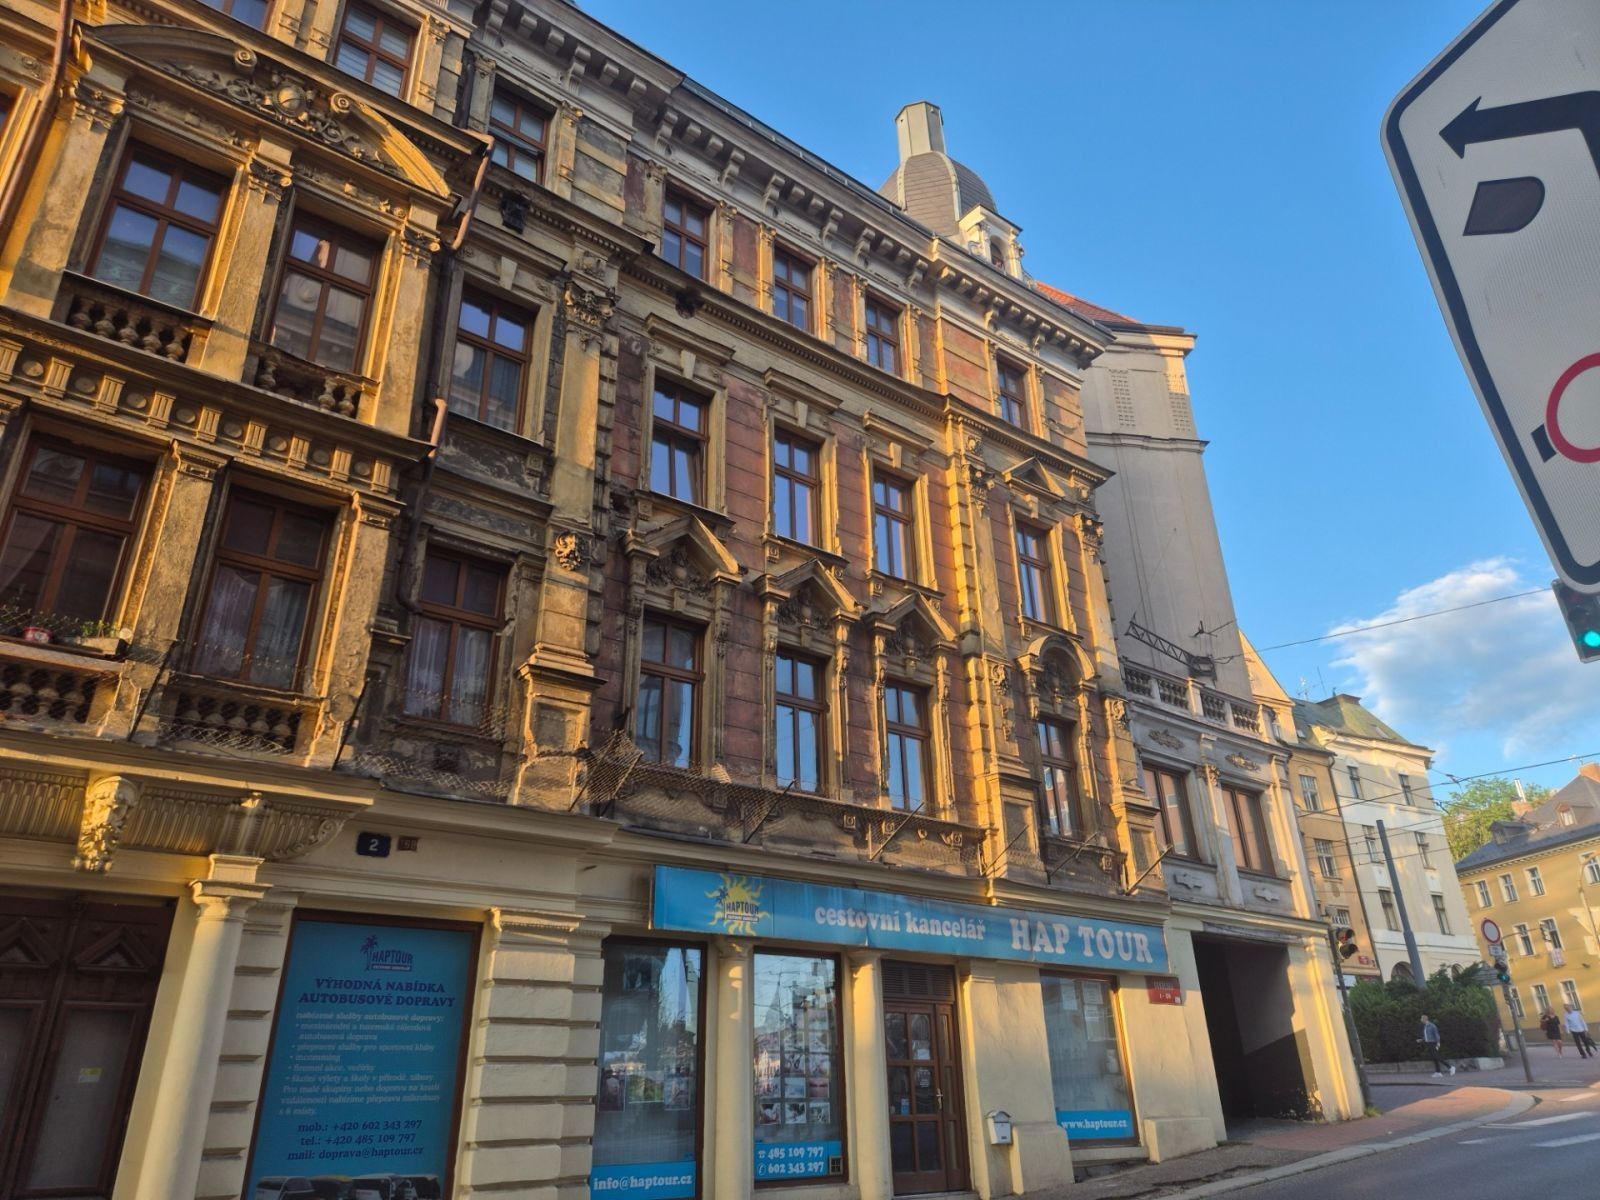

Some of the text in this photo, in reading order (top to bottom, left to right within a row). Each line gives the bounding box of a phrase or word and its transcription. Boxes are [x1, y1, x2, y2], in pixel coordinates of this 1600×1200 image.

[369, 838, 379, 851] 2
[726, 901, 760, 915] HAPTOUR
[815, 906, 1153, 963] cestovní kancelář HAP TOUR
[372, 949, 413, 964] HAPTOUR
[315, 976, 445, 993] VÝHODNÁ NABÍDKA
[299, 992, 456, 1007] AUTOBUSOVÉ DOPRAVY
[297, 1120, 422, 1133] mob.: +420 602 343 297
[1061, 1118, 1127, 1131] www.haptour.cz
[301, 1133, 416, 1145] tel.: +420 485 109 797
[288, 1146, 424, 1161] mail: doprava@haptour.cz
[768, 1146, 824, 1159] 485 109 797
[768, 1161, 824, 1174] 602 343 297
[593, 1175, 693, 1190] info@haptour.cz
